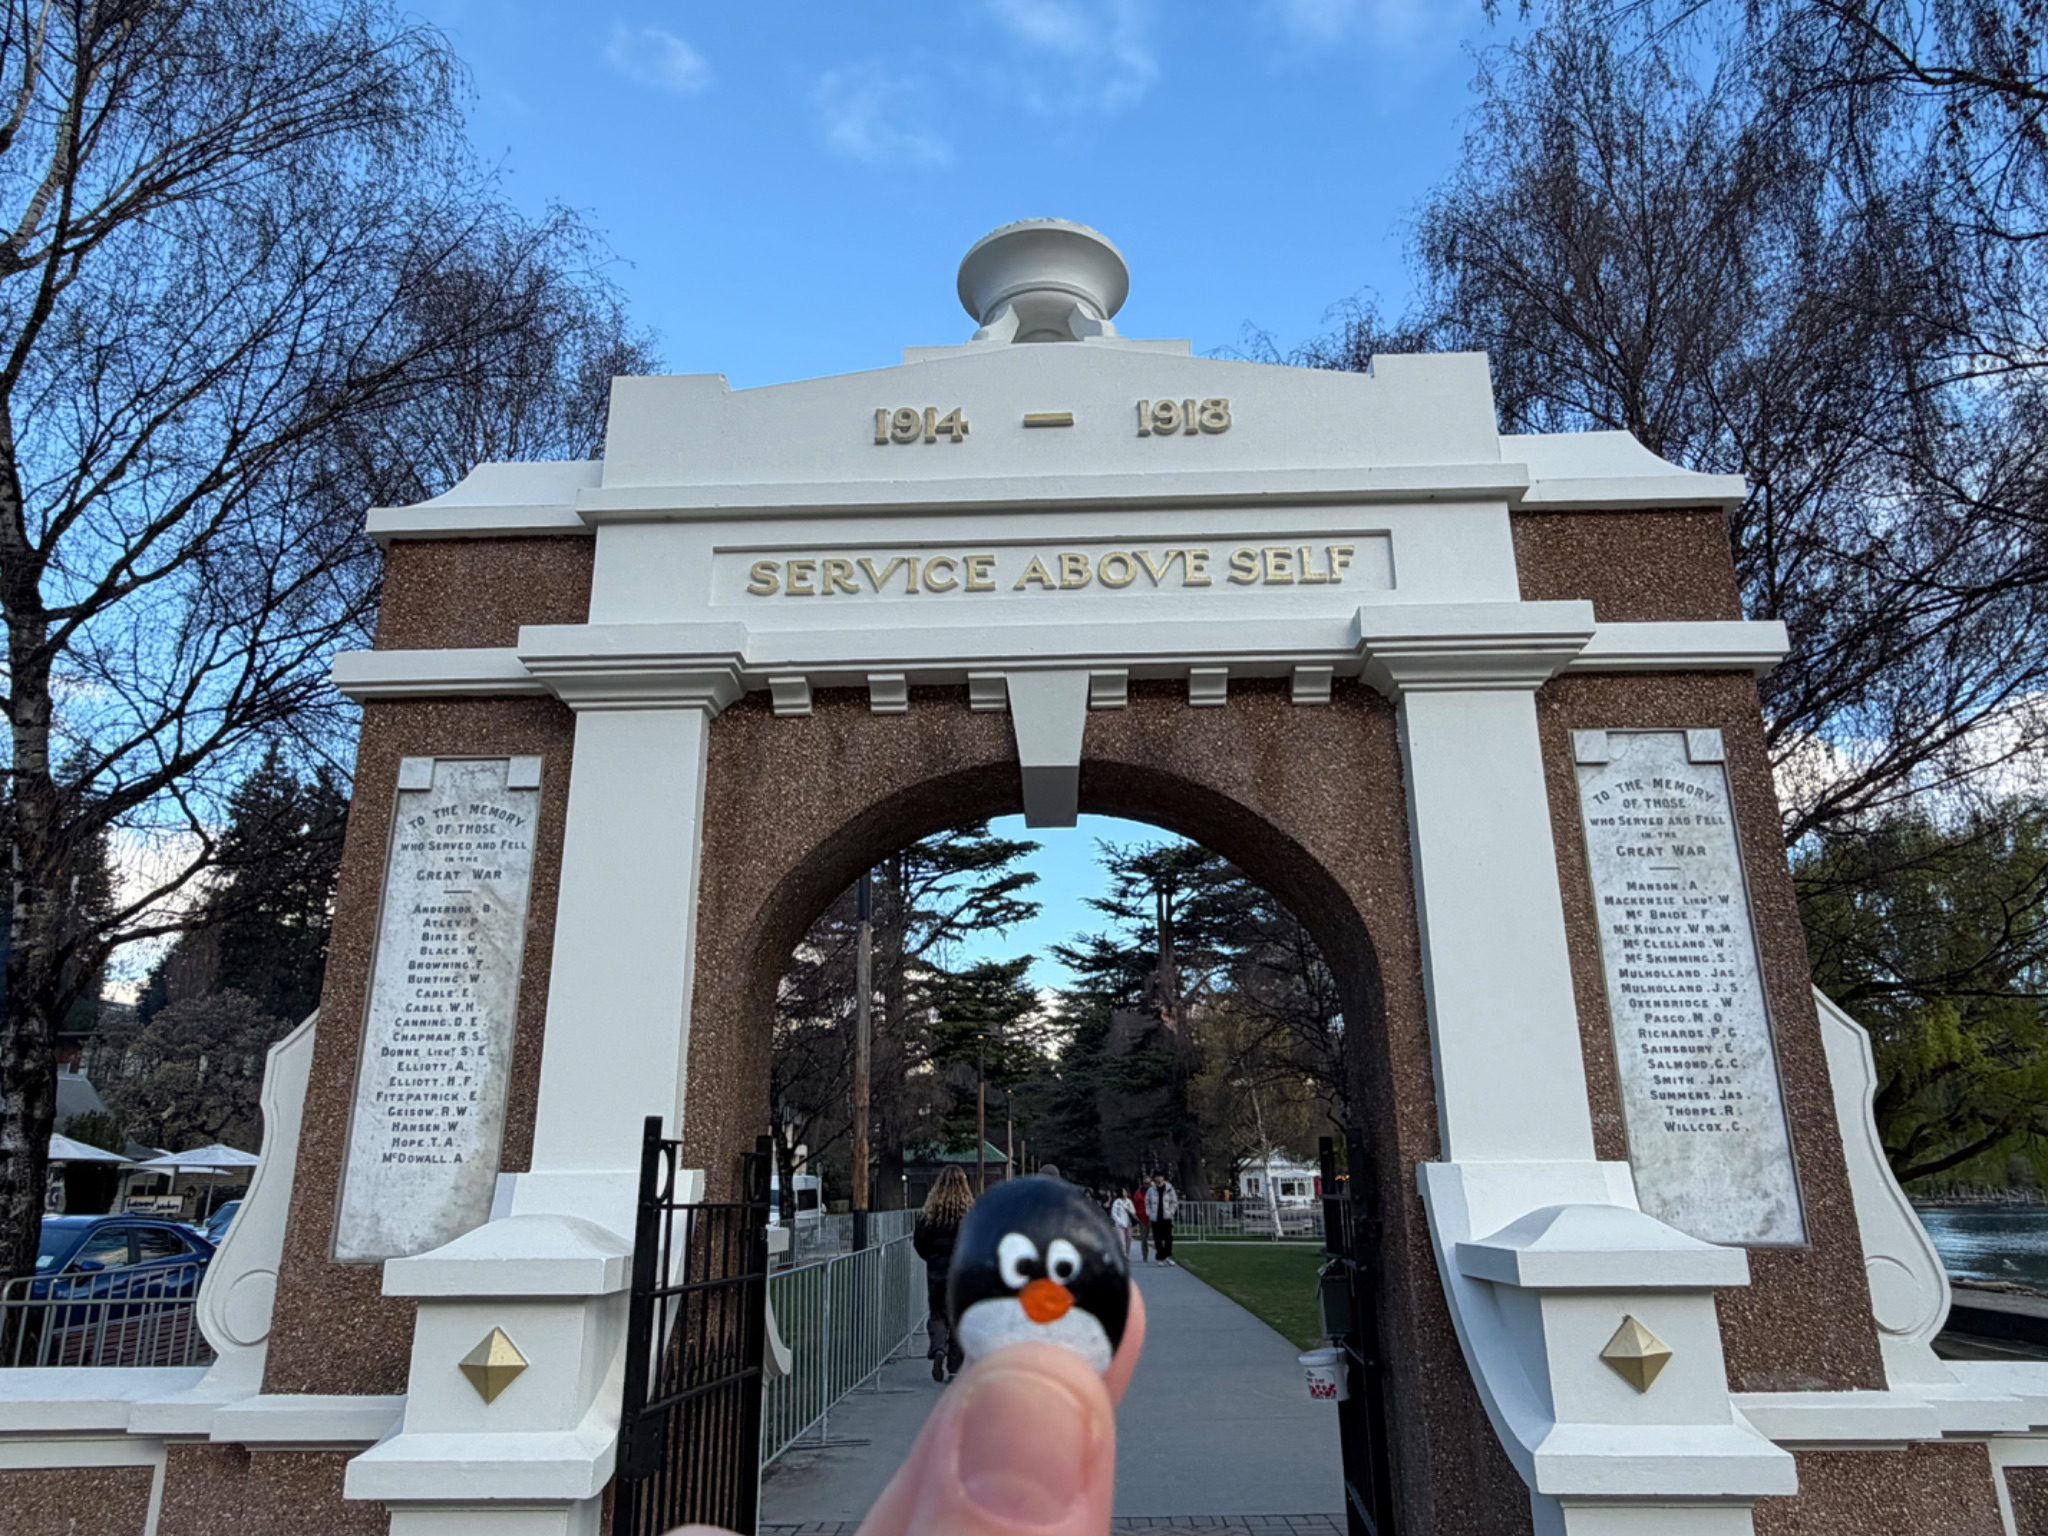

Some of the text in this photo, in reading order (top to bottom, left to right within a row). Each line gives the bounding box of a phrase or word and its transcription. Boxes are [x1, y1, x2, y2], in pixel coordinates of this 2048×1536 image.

[875, 407, 968, 444] 1914
[1136, 398, 1232, 437] 1918
[747, 544, 1355, 597] SERVICE ABOVE SELF
[1593, 778, 1715, 804] TO THE MEMORY
[1623, 798, 1686, 809] OF THOSE
[408, 804, 525, 829] TO THE MEMORY
[1590, 816, 1726, 826] WHO SERVED AND FELL
[436, 823, 496, 835] OF THOSE
[401, 840, 527, 851] WHO SERVED AND FELL
[1616, 845, 1707, 857] GREAT WAR
[416, 869, 502, 881] GREAT WAR
[1604, 896, 1675, 906] MACKENZIE
[381, 1047, 419, 1057] DONNE
